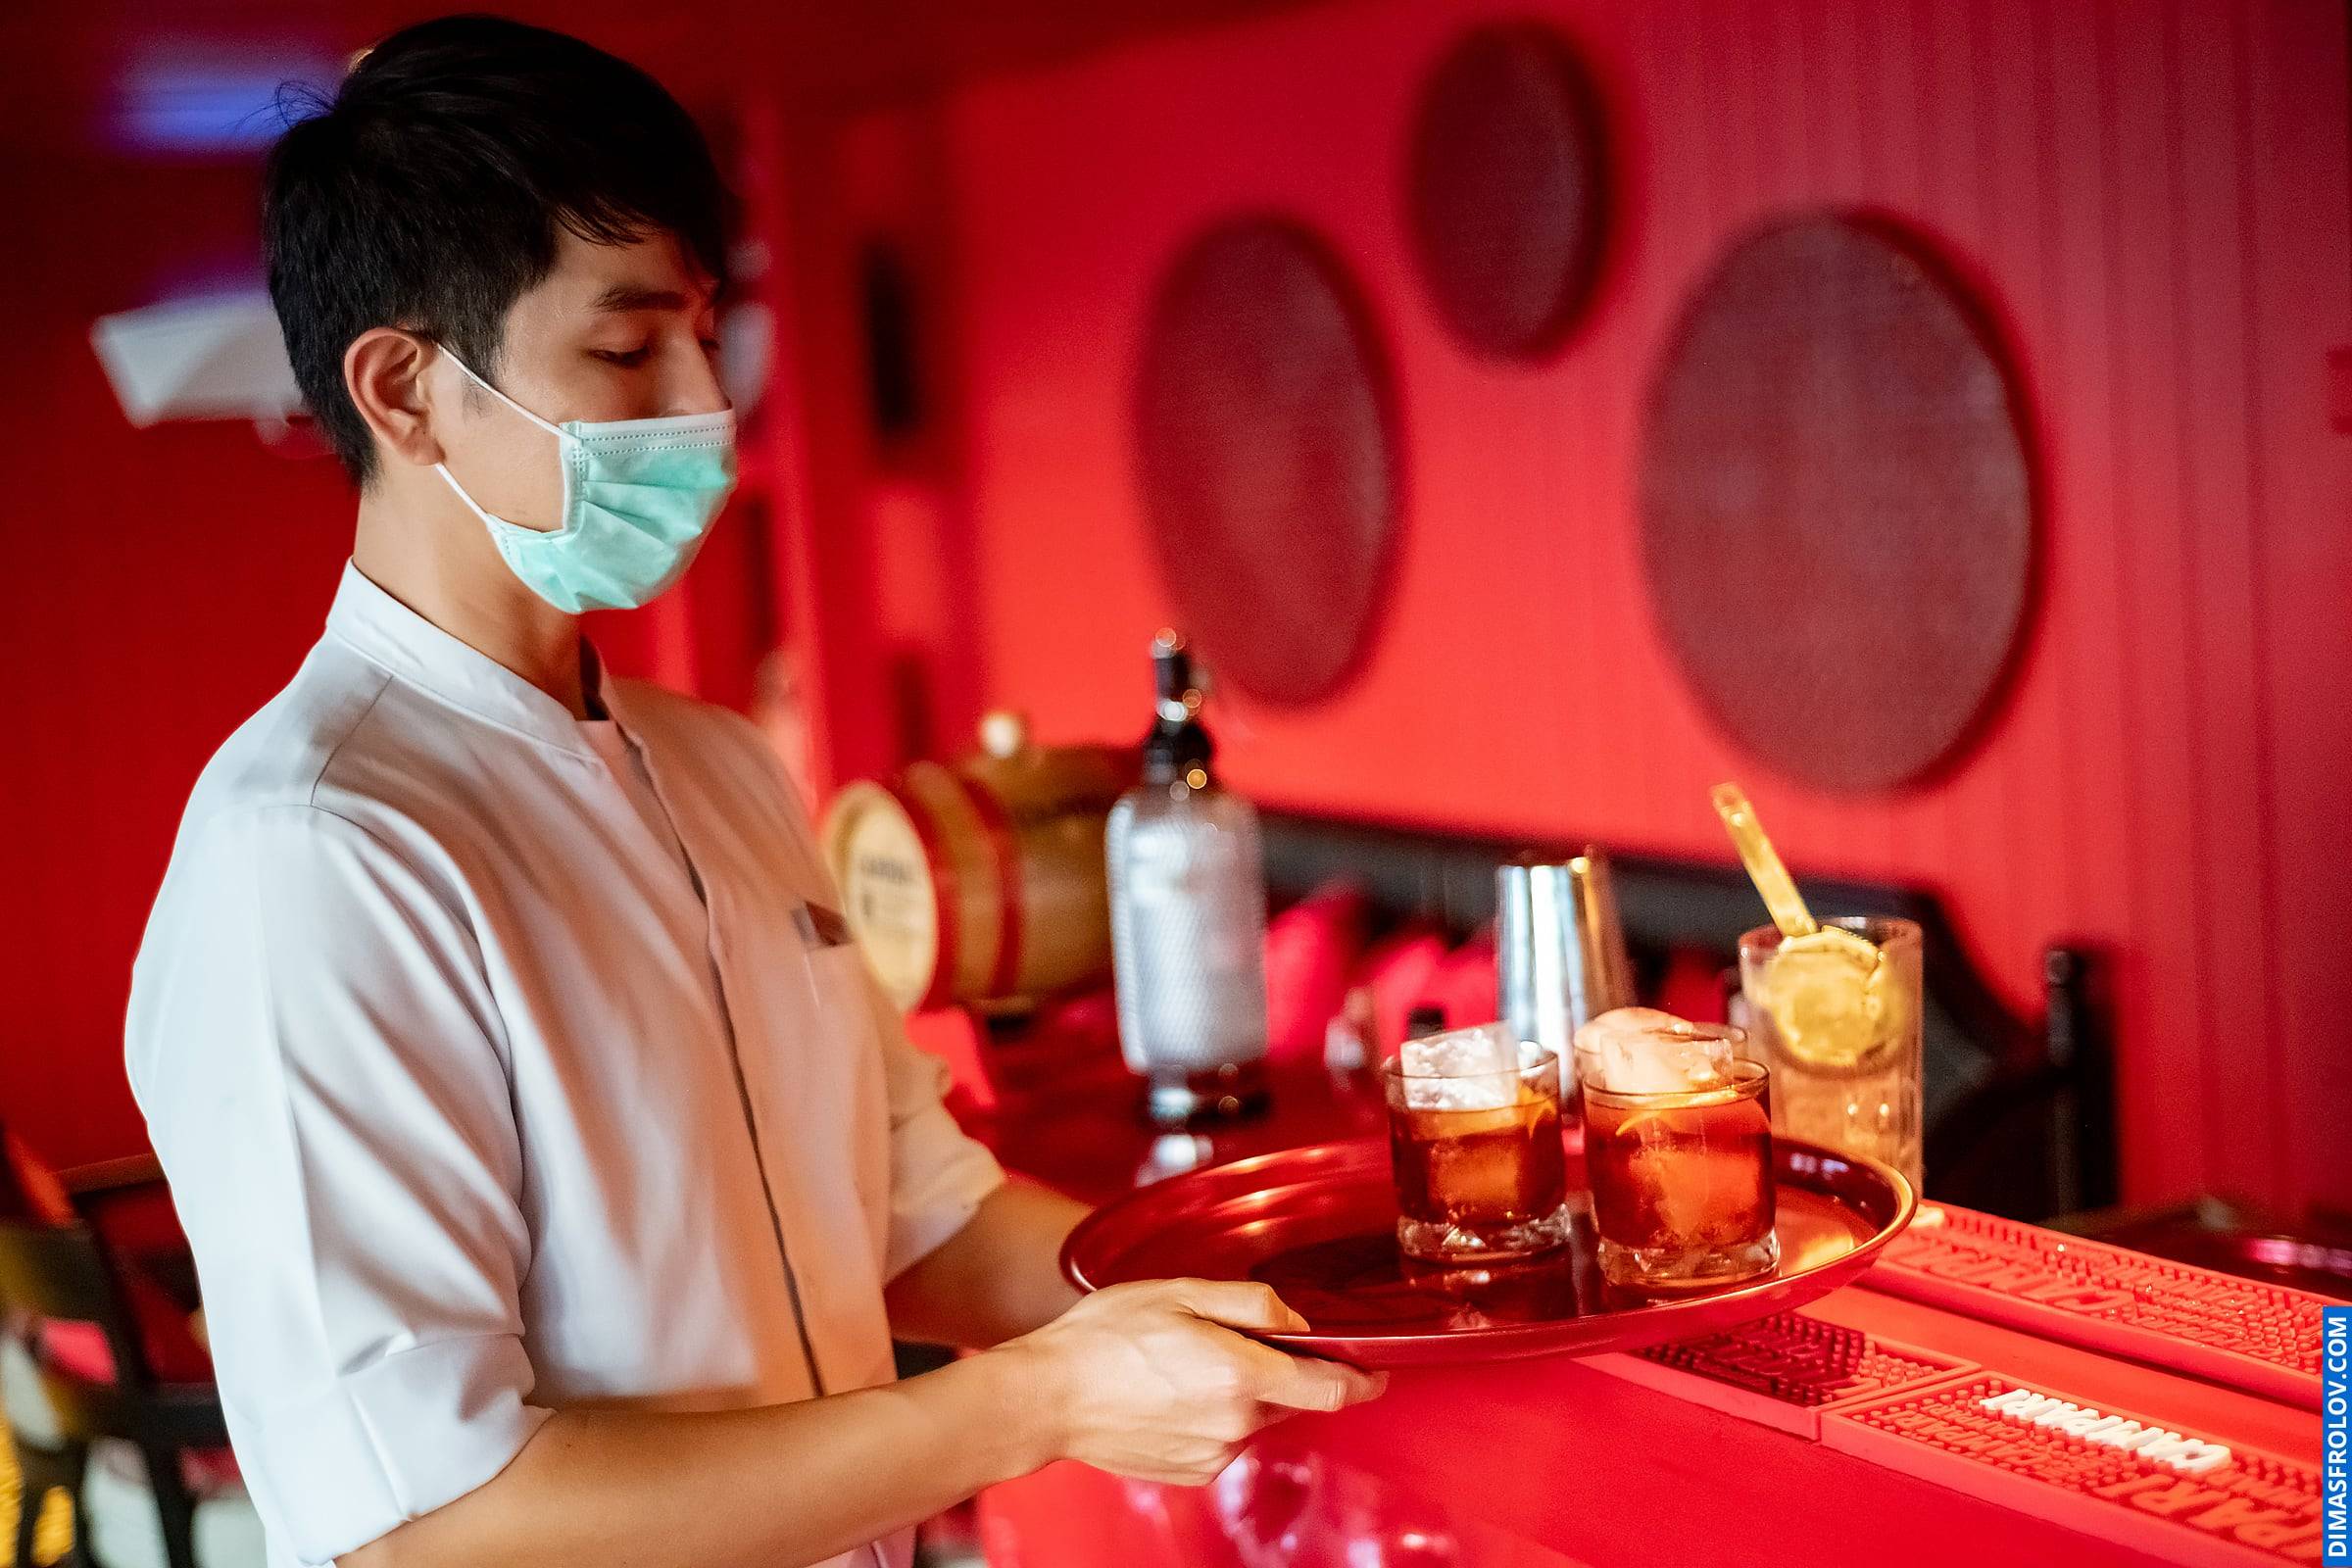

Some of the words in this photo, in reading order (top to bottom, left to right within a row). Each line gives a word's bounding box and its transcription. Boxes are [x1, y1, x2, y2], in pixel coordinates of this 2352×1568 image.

[1876, 1409, 2053, 1465] CAMPARI
[1919, 1402, 2028, 1443] CAMPARI
[1979, 1388, 2233, 1473] CAMPARI
